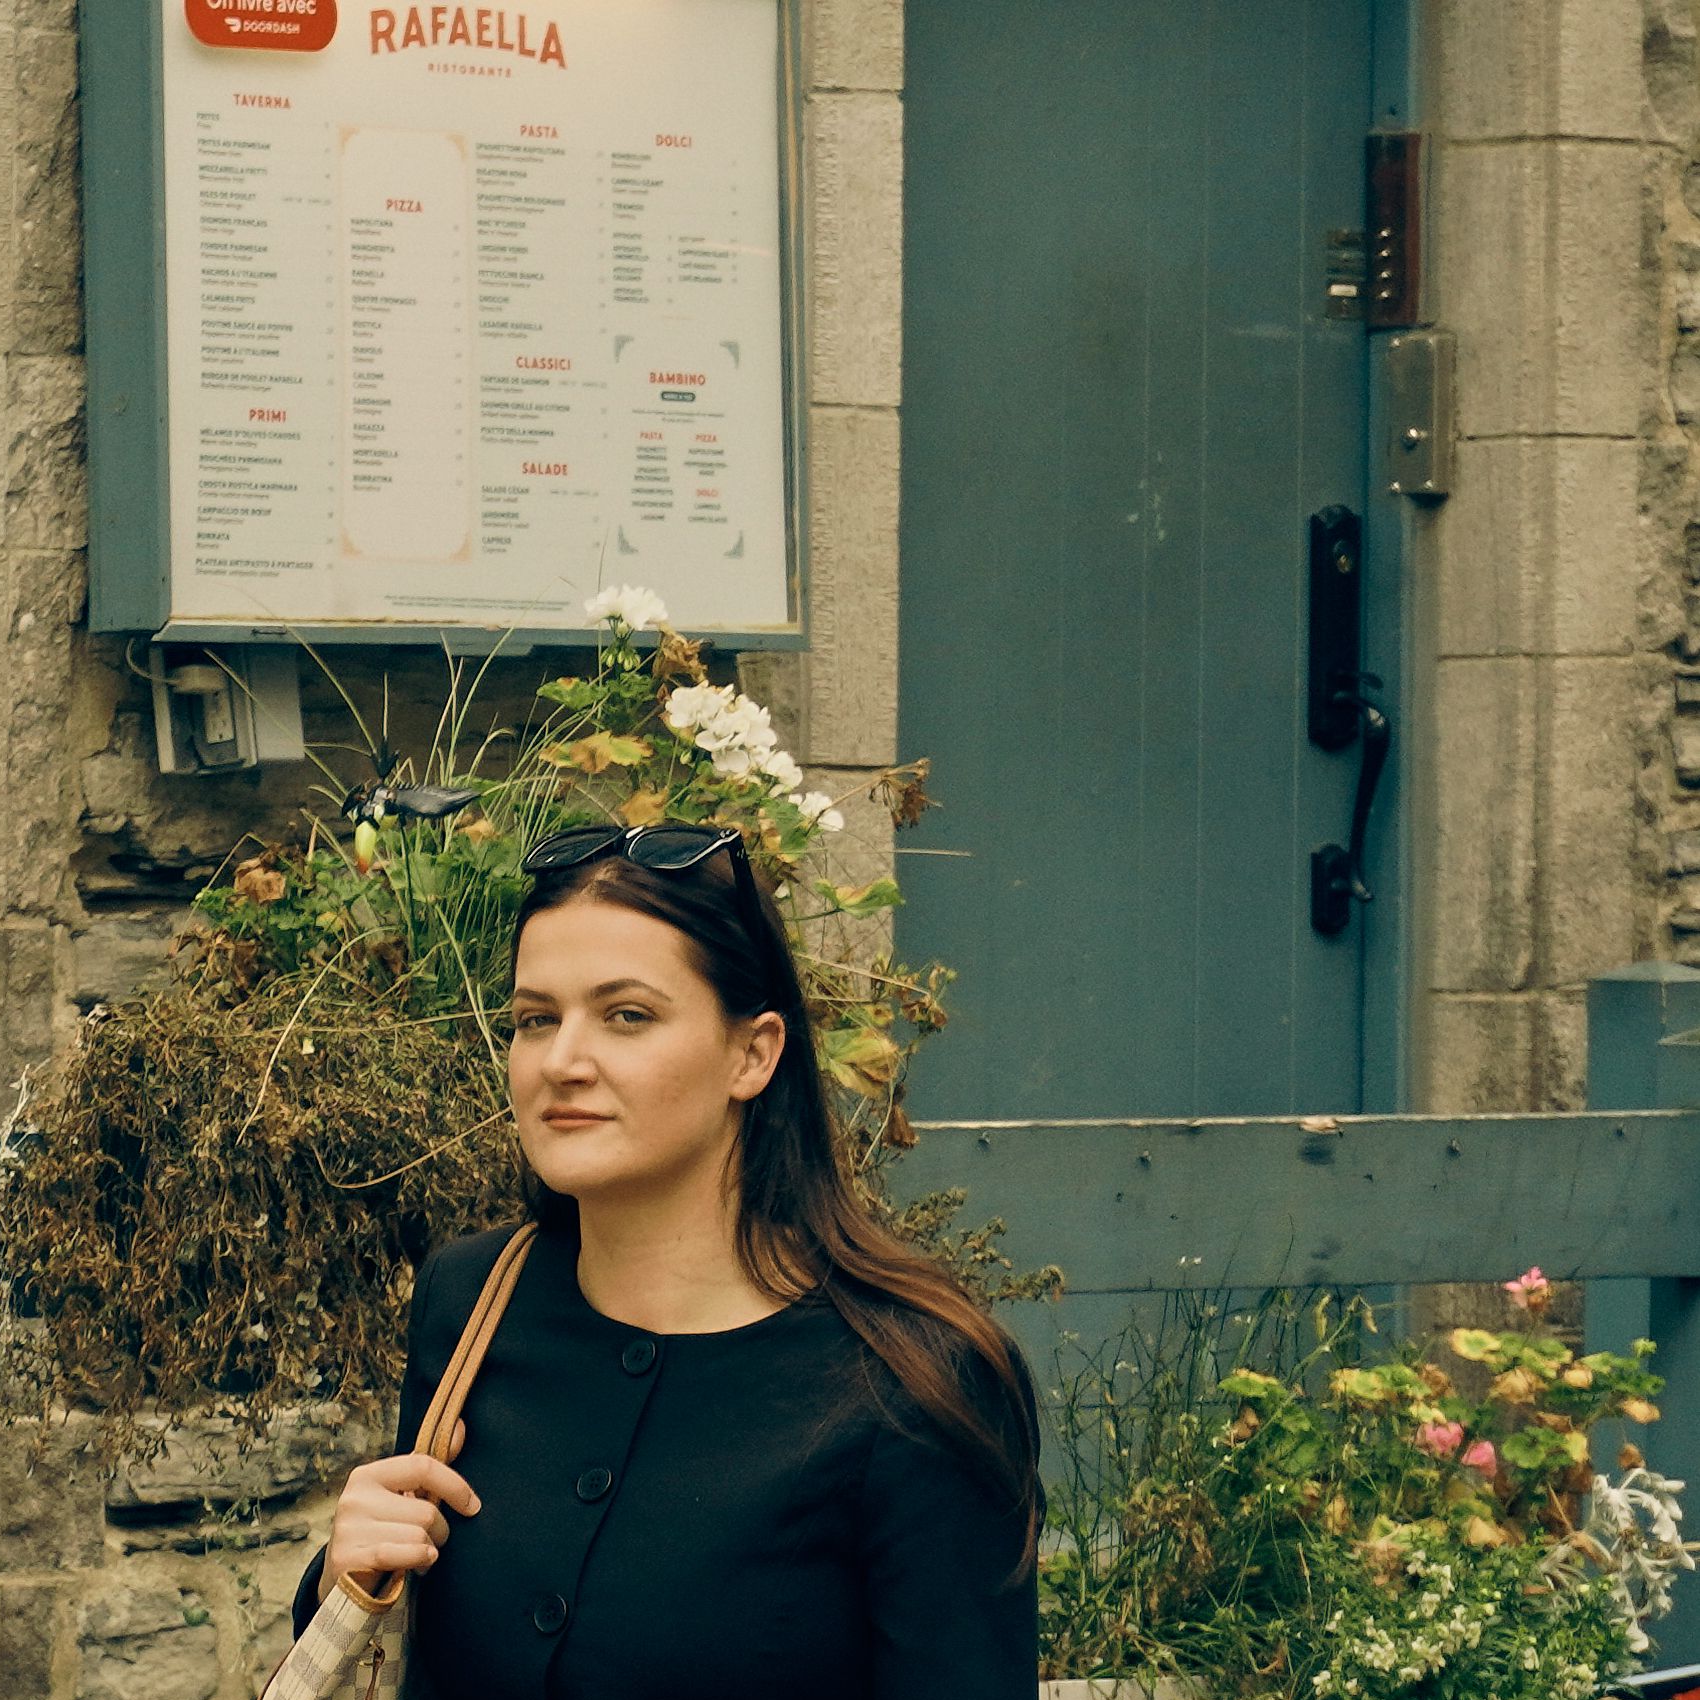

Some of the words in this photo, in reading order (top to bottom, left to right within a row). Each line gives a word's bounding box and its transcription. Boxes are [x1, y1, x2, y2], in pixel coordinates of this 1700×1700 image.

[276, 0, 317, 14] avec
[243, 20, 300, 34] DOORDASH
[370, 6, 567, 70] RAFAELLA
[427, 63, 512, 79] RISTORANTE
[233, 94, 291, 109] TAVERNA
[520, 125, 560, 139] PASTA
[655, 134, 692, 148] DOLCI
[386, 198, 423, 213] PIZZA
[516, 356, 571, 371] CLASSICI
[650, 372, 706, 386] BAMBINO
[249, 409, 287, 422] PRIMI
[522, 462, 568, 476] SALADE
